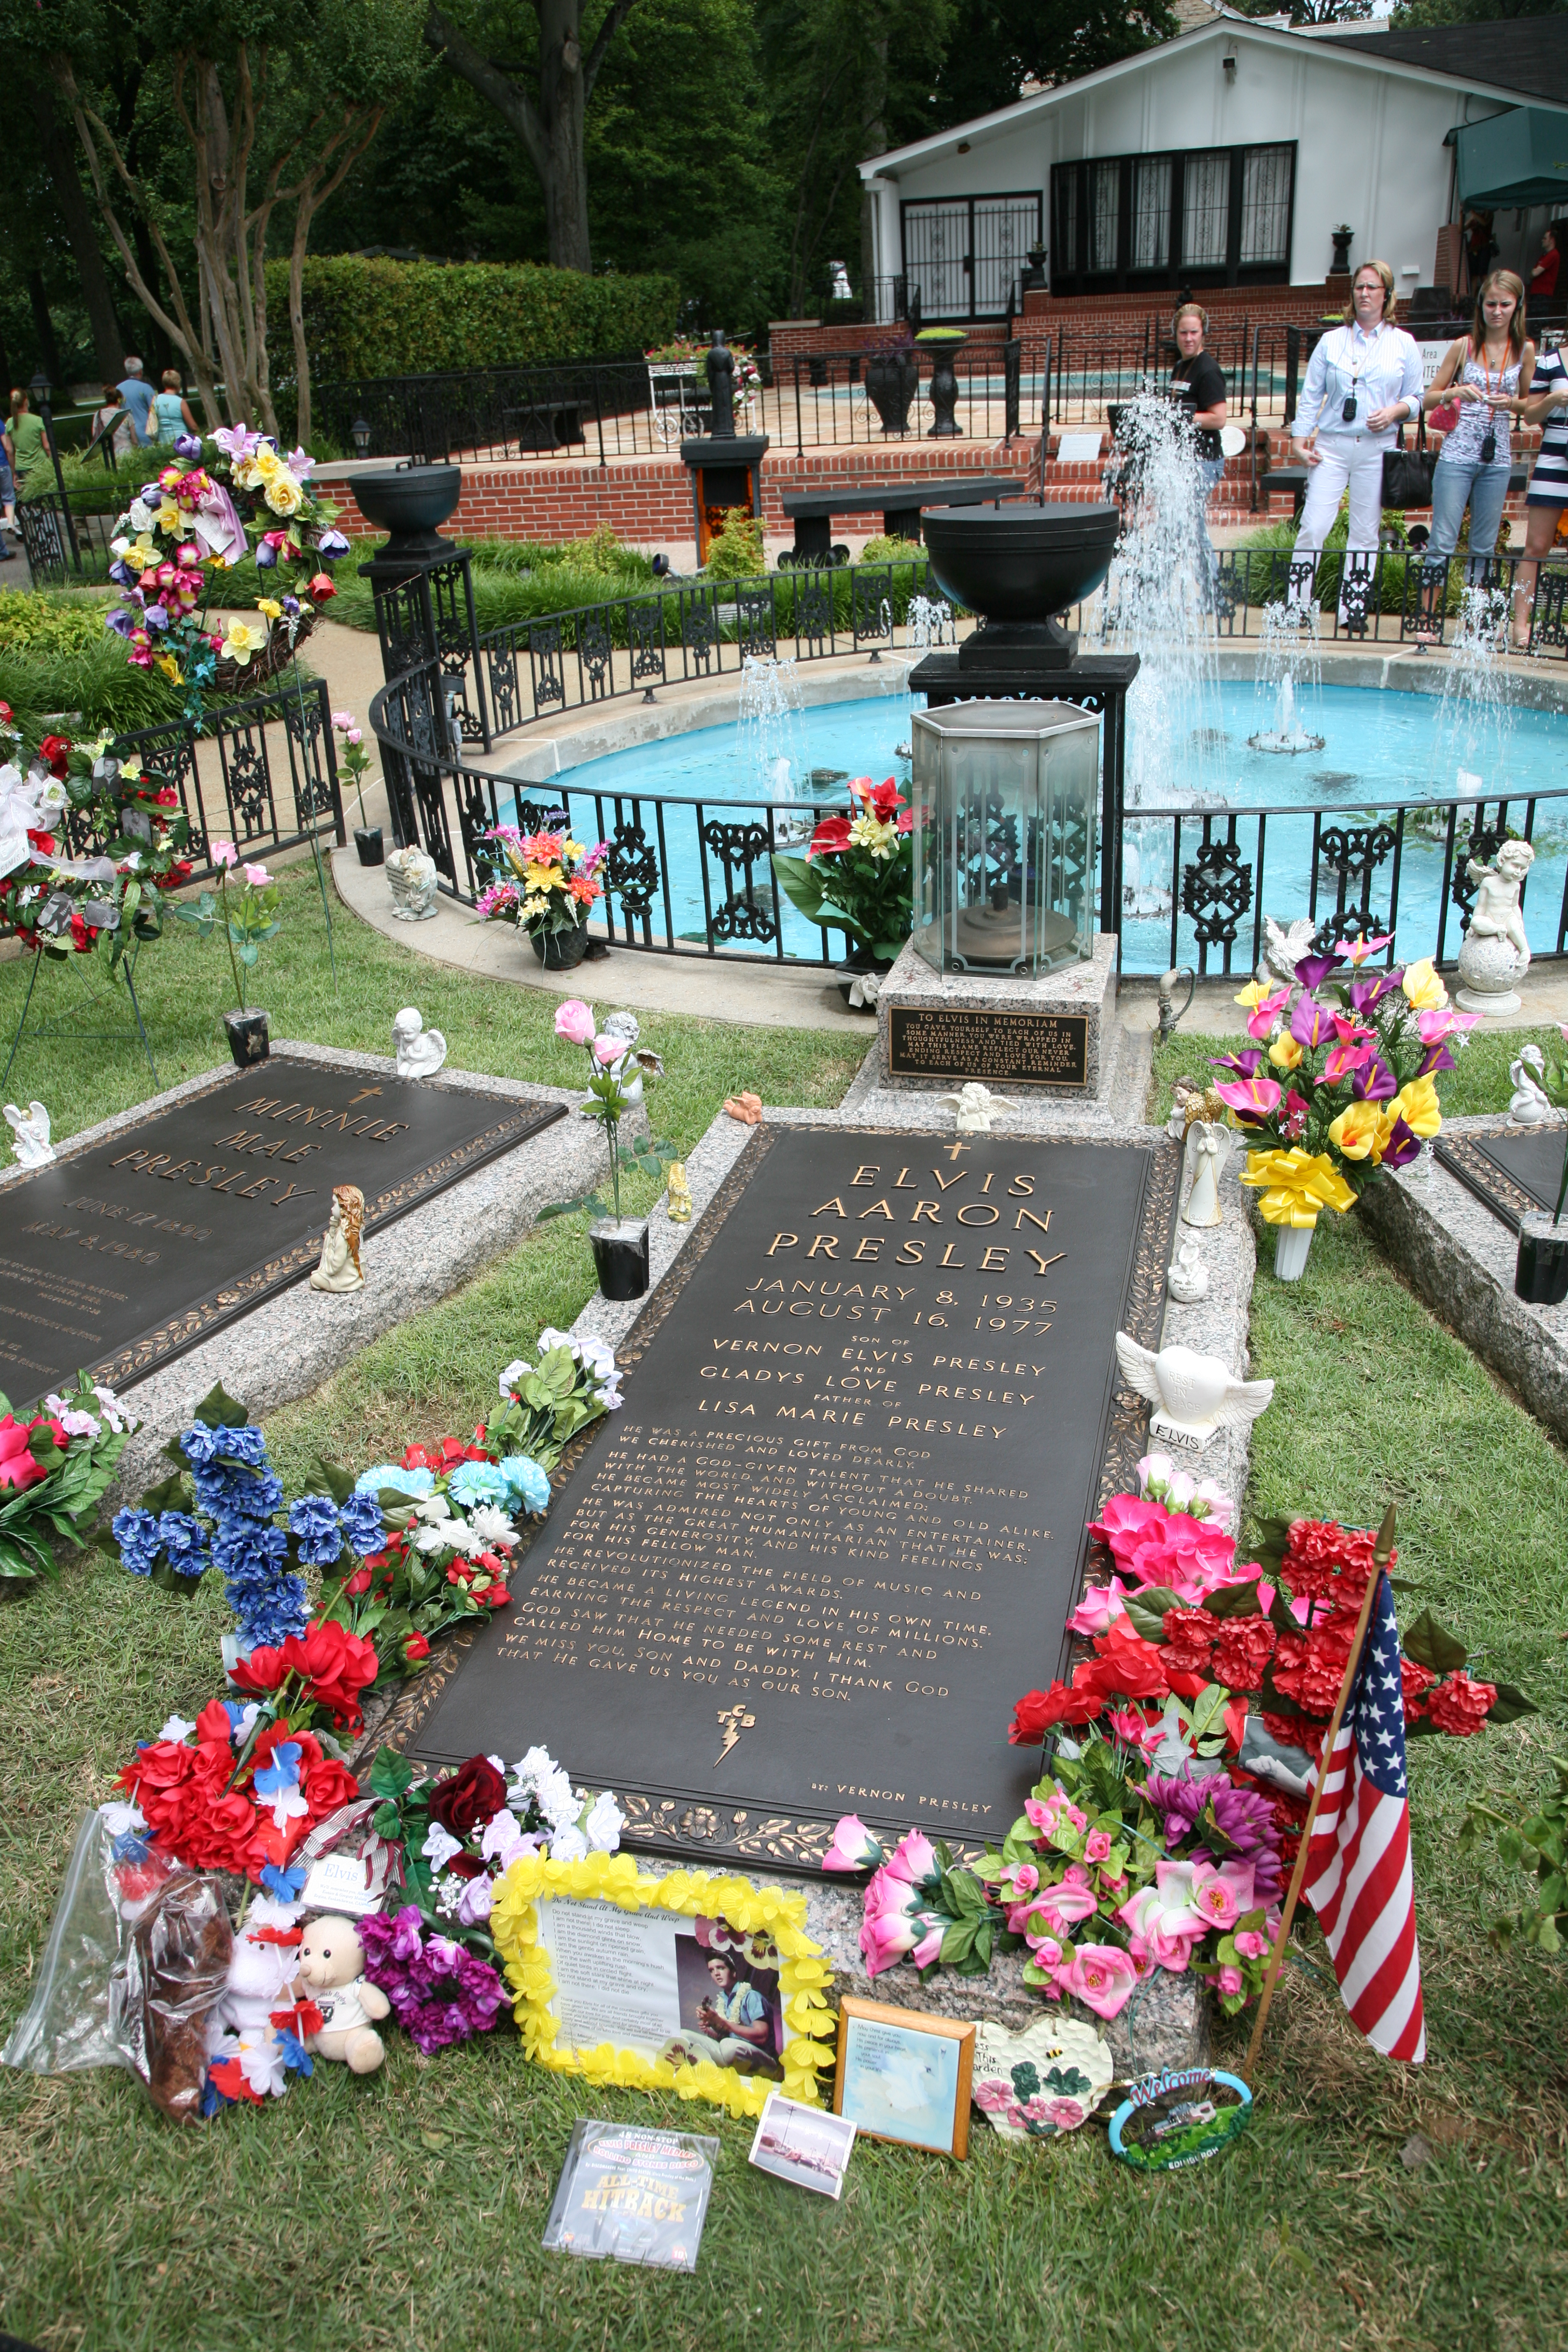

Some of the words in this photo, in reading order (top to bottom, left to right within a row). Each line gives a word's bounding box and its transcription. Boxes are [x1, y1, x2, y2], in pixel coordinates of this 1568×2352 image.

[1422, 348, 1437, 359] Area
[919, 1013, 933, 1021] TO
[939, 1014, 969, 1024] ELVIS
[975, 1016, 988, 1024] IN
[994, 1017, 1057, 1028] MEMORIAM
[902, 1035, 975, 1044] THOUGHTFULNESS
[232, 1095, 411, 1144] MINNIE
[211, 1130, 321, 1164] MAE
[109, 1149, 318, 1207] PRESLEY
[849, 1165, 1036, 1196] ELVIS
[62, 1196, 129, 1219] JUNE
[152, 1219, 213, 1240] 1890
[809, 1196, 1054, 1233] AARON
[20, 1221, 82, 1240] MAY
[97, 1241, 161, 1264] 1980
[765, 1232, 1066, 1275] PRESLEY
[745, 1277, 916, 1301] JANUARY
[935, 1290, 959, 1306] 8,
[981, 1293, 1058, 1313] 1935
[733, 1298, 892, 1323] AUGUST
[913, 1311, 949, 1328] 16,
[974, 1315, 1053, 1336] 1977
[851, 1335, 881, 1344] SON
[891, 1339, 910, 1347] OF
[712, 1338, 823, 1356] VERNON
[841, 1347, 913, 1364] ELVIS
[932, 1355, 1045, 1377] PRESLEY
[850, 1364, 886, 1375] AND
[699, 1366, 805, 1384] GLADYS
[825, 1375, 898, 1392] LOVE
[918, 1383, 1035, 1406] PRESLEY
[1168, 1371, 1195, 1389] REST
[1174, 1386, 1187, 1398] IN
[813, 1394, 872, 1406] FATHER
[881, 1400, 901, 1409] OF
[1165, 1395, 1201, 1412] PEACE
[697, 1399, 756, 1416] LISA
[775, 1405, 866, 1426] MARIE
[887, 1415, 1007, 1439] PRESLEY
[619, 1434, 640, 1445] WE
[647, 1437, 736, 1451] CHERISHED
[744, 1445, 778, 1455] AND
[788, 1448, 842, 1461] LOVED
[852, 1455, 914, 1469] DEARLY.
[622, 1425, 642, 1434] HE
[651, 1426, 681, 1436] WAS
[705, 1431, 784, 1445] PRECIOUS
[793, 1438, 830, 1449] GIFT
[839, 1443, 883, 1454] FROM
[893, 1446, 931, 1459] GOD
[1156, 1425, 1199, 1450] ELVIS
[607, 1450, 628, 1460] HE
[635, 1452, 670, 1462] HAD
[676, 1456, 687, 1464] A
[695, 1455, 797, 1474] GOD-GIVEN
[809, 1467, 869, 1482] TALENT
[879, 1474, 925, 1487] THAT
[934, 1481, 954, 1491] HE
[964, 1483, 1029, 1499] SHARED
[562, 1531, 594, 1542] FOR
[604, 1534, 631, 1545] HIS
[640, 1538, 706, 1553] FELLOW
[715, 1546, 757, 1559] MAN.
[546, 1558, 631, 1575] RECEIVED
[641, 1568, 667, 1580] ITS
[678, 1572, 756, 1589] HIGHEST
[765, 1583, 843, 1599] AWARDS.
[554, 1545, 575, 1556] HE
[582, 1548, 732, 1572] REVOLUTIONIZED
[741, 1565, 773, 1577] THE
[782, 1570, 832, 1584] FIELD
[842, 1577, 865, 1587] OF
[873, 1580, 933, 1595] MUSIC
[943, 1588, 982, 1601] AND
[836, 1784, 906, 1802] VERNON
[918, 1795, 992, 1814] PRESLEY
[323, 1863, 358, 1881] Elvis
[578, 1901, 598, 1910] Stand
[609, 1906, 622, 1914] My
[645, 1912, 659, 1920] And
[661, 1915, 680, 1923] Weep
[584, 1952, 605, 1960] awaken
[974, 2063, 1003, 2075] arden
[976, 2052, 996, 2064] This
[1131, 2070, 1210, 2105] Welcome
[598, 2139, 622, 2149] ELVIS
[624, 2139, 661, 2153] PRESLEY
[660, 2145, 697, 2159] MEDLEY
[619, 2131, 632, 2139] 48
[593, 2145, 631, 2165] ROLLING
[632, 2159, 667, 2169] STONES
[669, 2160, 698, 2169] DISCO
[597, 2174, 679, 2199] ALL-TIME
[582, 2188, 686, 2222] HITBACK
